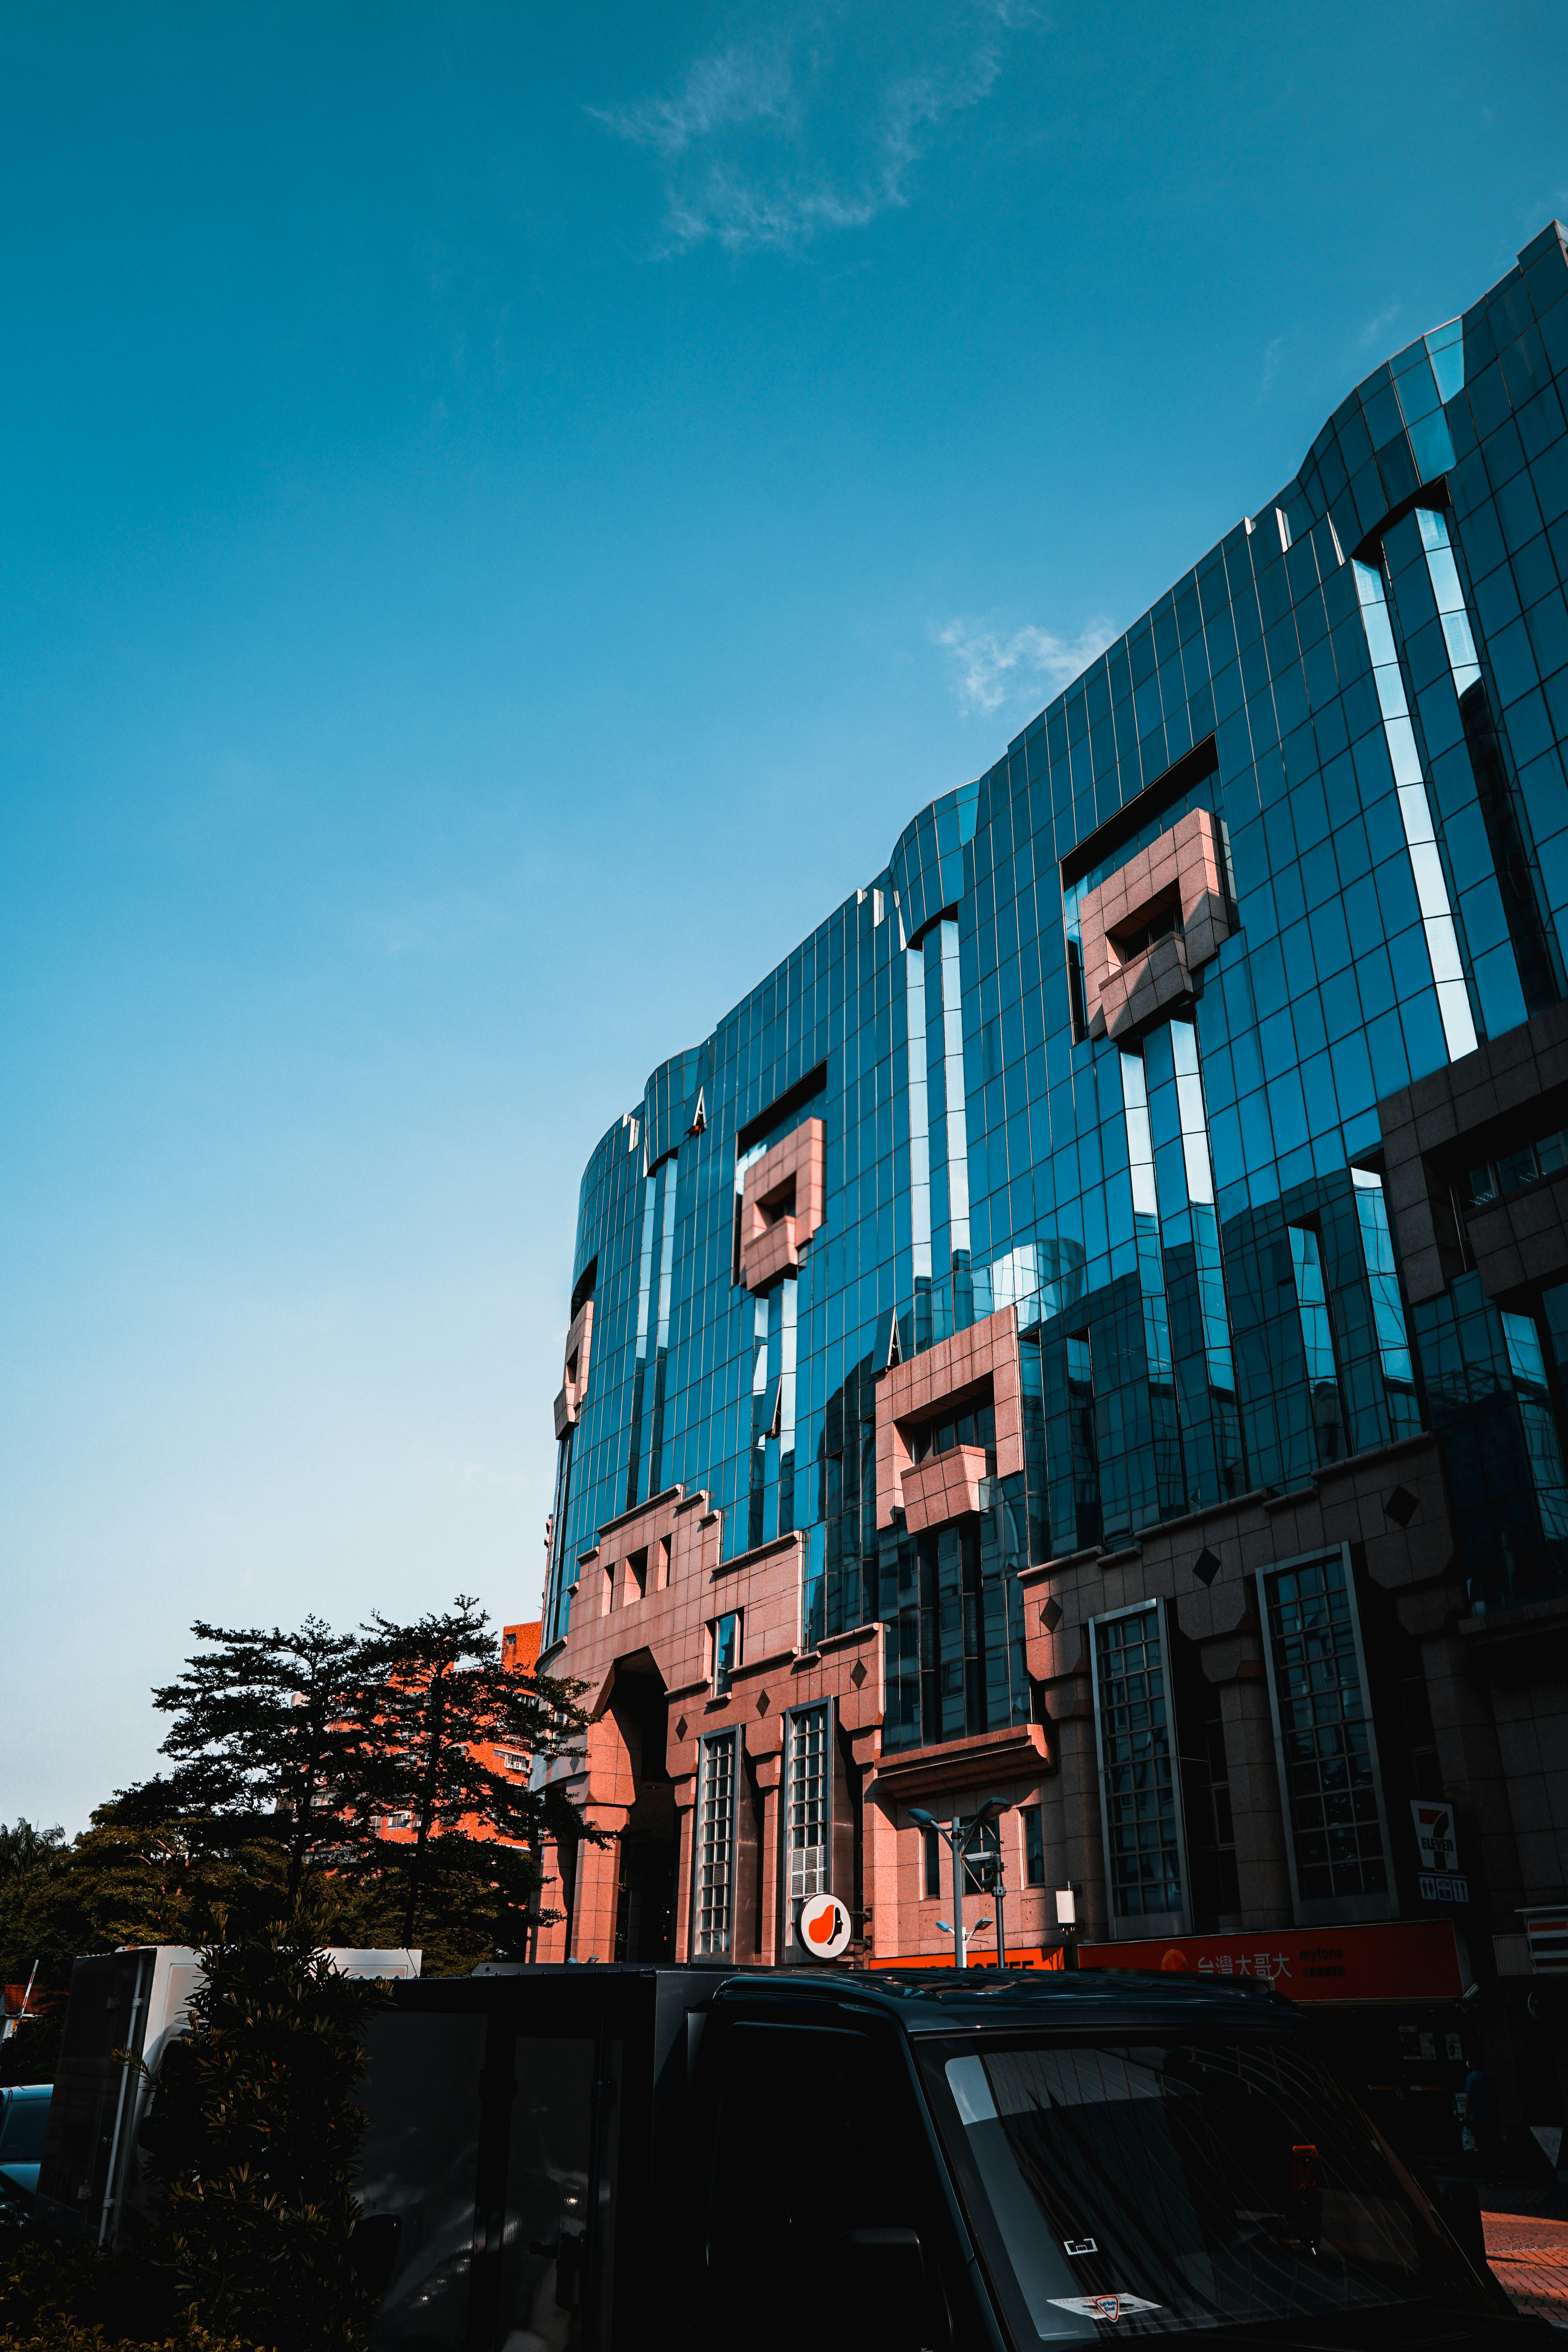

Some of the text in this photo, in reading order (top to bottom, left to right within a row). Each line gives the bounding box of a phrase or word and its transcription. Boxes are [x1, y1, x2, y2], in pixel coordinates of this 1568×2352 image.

[1418, 1808, 1449, 1871] 7
[1198, 1952, 1292, 1979] 台灣大哥大
[1300, 1946, 1343, 1964] myfone
